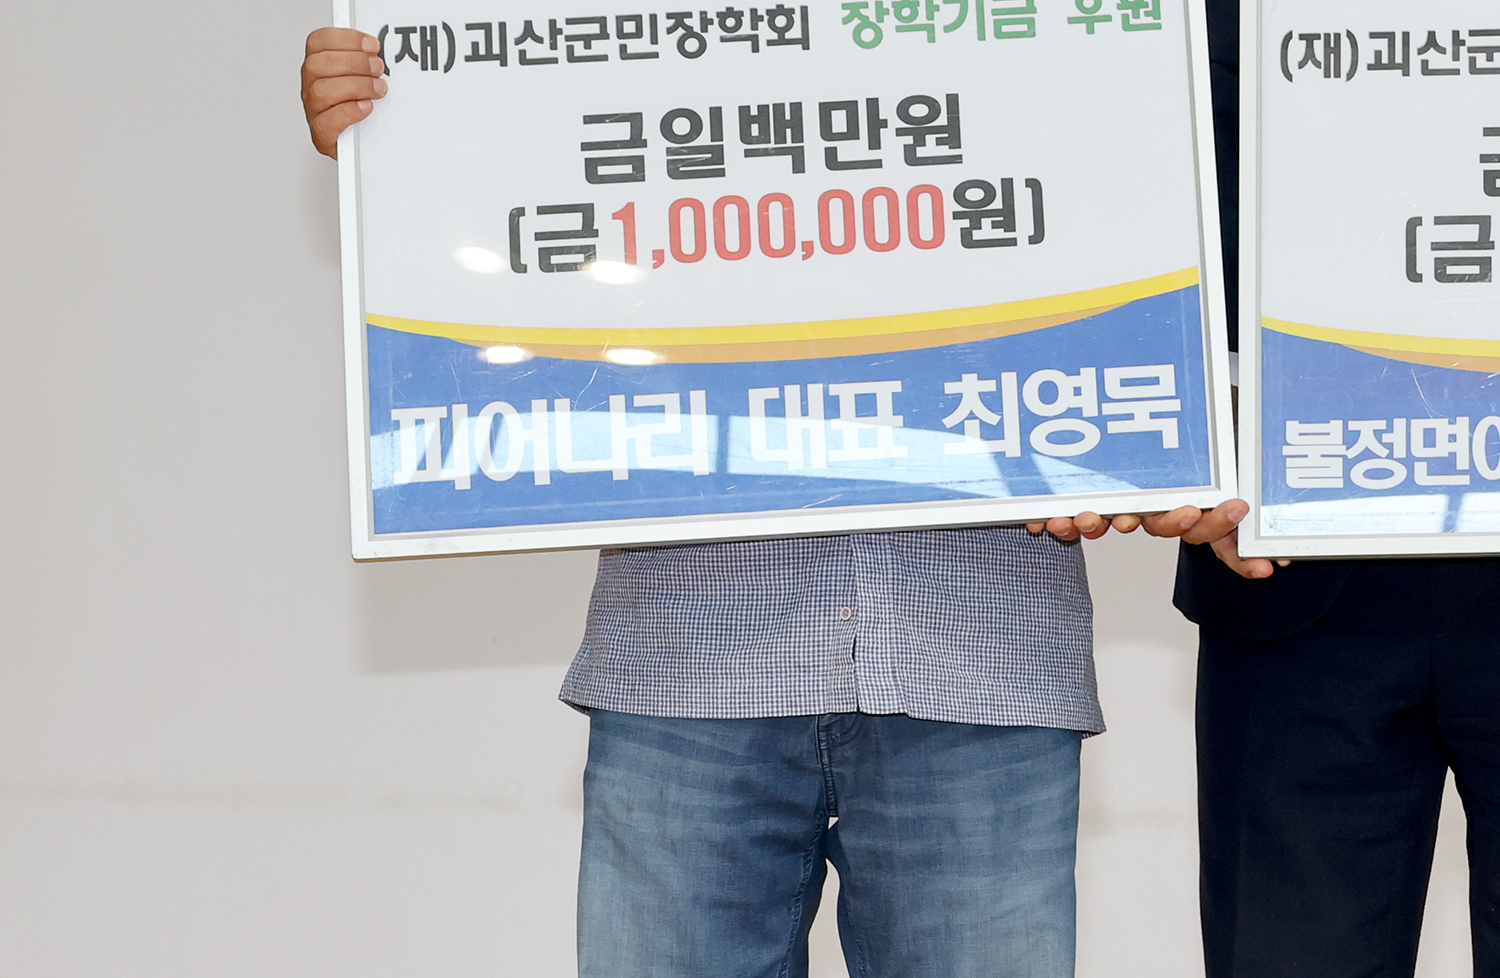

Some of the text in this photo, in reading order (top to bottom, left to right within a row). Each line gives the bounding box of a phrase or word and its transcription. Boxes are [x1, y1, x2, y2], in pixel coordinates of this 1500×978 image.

[377, 3, 811, 76] (재)괴산군민장학회
[580, 93, 964, 184] 금일백만원
[390, 363, 1182, 490] 피어나리 대표 최영묵
